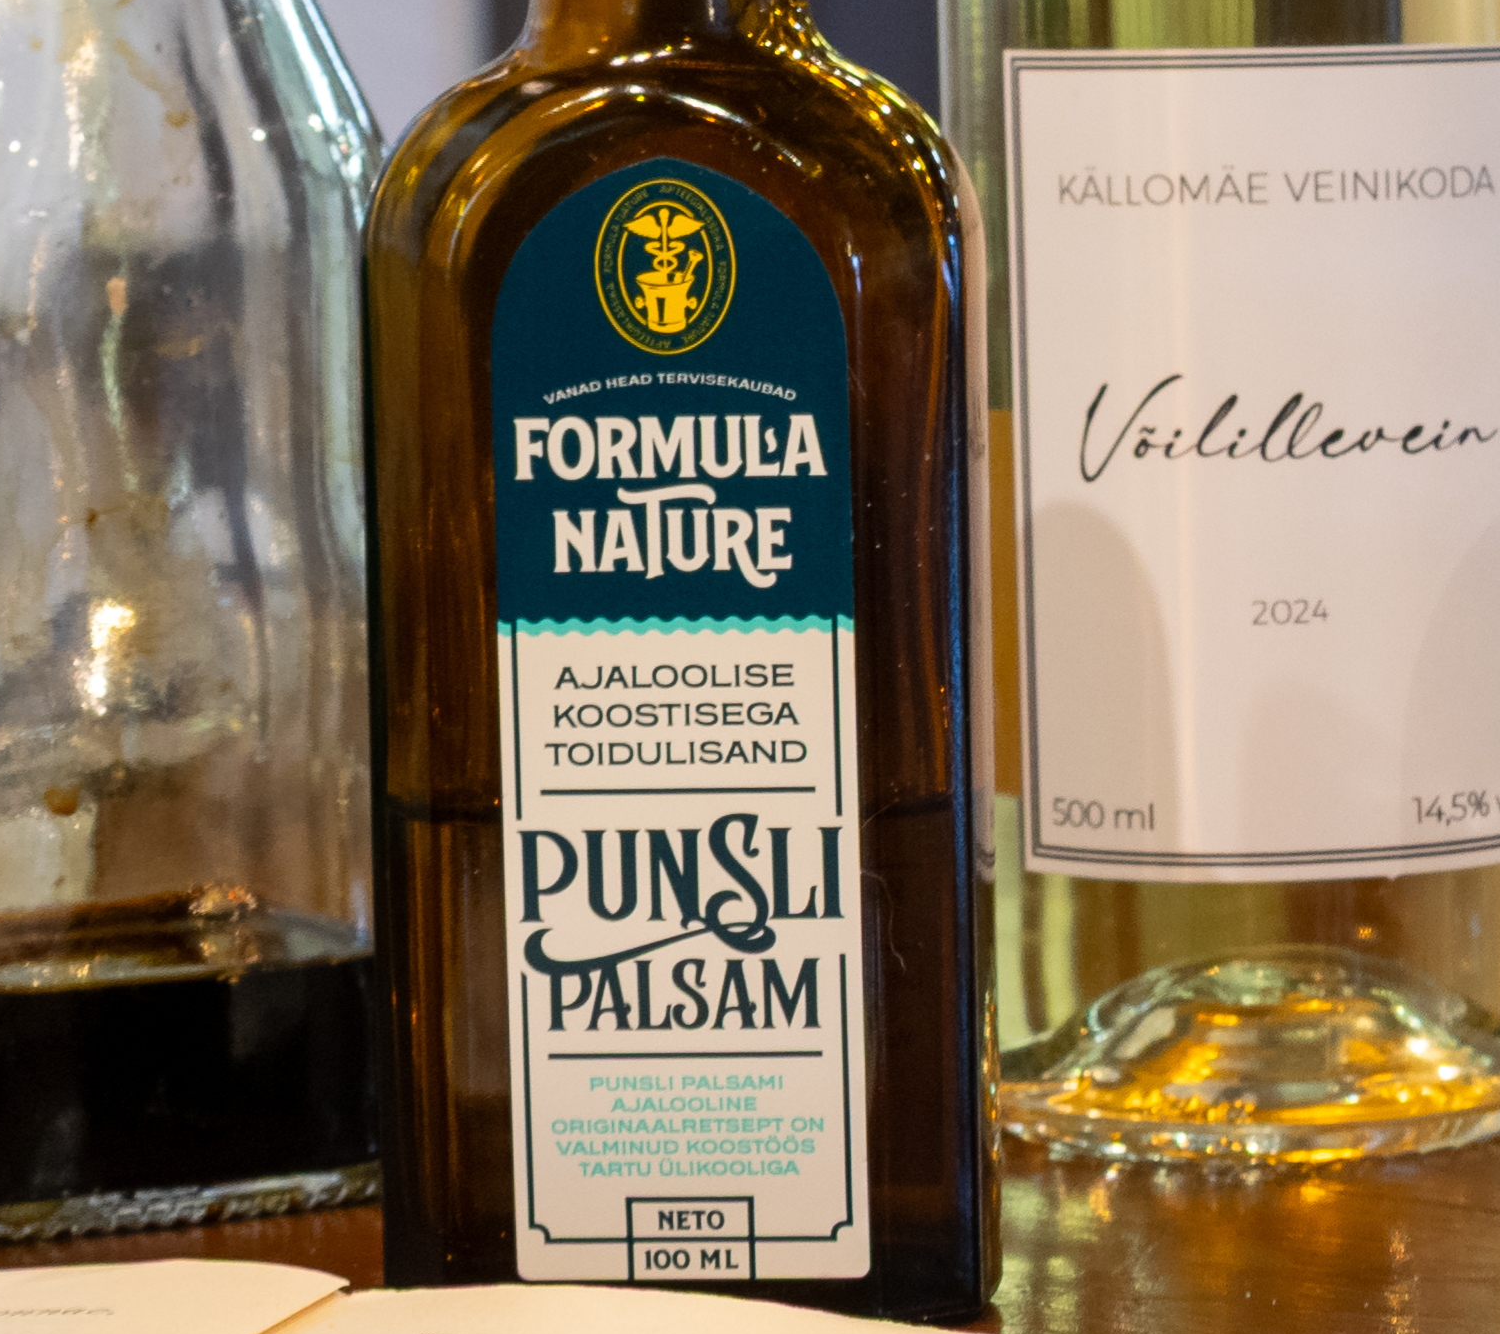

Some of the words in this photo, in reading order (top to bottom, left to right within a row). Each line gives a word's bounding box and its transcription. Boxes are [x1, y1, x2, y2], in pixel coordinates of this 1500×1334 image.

[1057, 166, 1268, 207] KÄLLOMÄE
[1285, 164, 1496, 204] VEINIKODA
[543, 380, 602, 405] VANAD
[606, 373, 653, 389] HEAD
[657, 372, 797, 402] TERVISEKAUBAD
[1078, 374, 1498, 483] Võilillevein
[514, 414, 828, 481] FORMULA
[553, 484, 793, 588] NATURE
[1252, 598, 1329, 626] 2024
[554, 663, 795, 690] AJALOOLISE
[553, 702, 799, 728] KOOSTISEGA
[545, 740, 807, 767] TOIDULISAND
[1052, 797, 1104, 830] 500
[1114, 803, 1155, 831] ml
[1412, 792, 1489, 829] 14,5%
[518, 813, 843, 953] PUNSLI
[548, 957, 821, 1032] PALSAM
[589, 1076, 674, 1092] PUNSLI
[681, 1075, 784, 1091] PALSAMI
[611, 1096, 757, 1113] AJALOOLINE
[551, 1117, 783, 1135] ORIGINAALRETSEPT
[790, 1116, 825, 1133] ON
[555, 1139, 679, 1157] VALMINUD
[686, 1135, 816, 1156] KOOSTÖÖS
[579, 1161, 652, 1178] TARTU
[659, 1157, 800, 1177] ÜLIKOOLIGA
[657, 1210, 725, 1231] NETO
[644, 1248, 690, 1271] 100
[700, 1248, 739, 1270] ML
